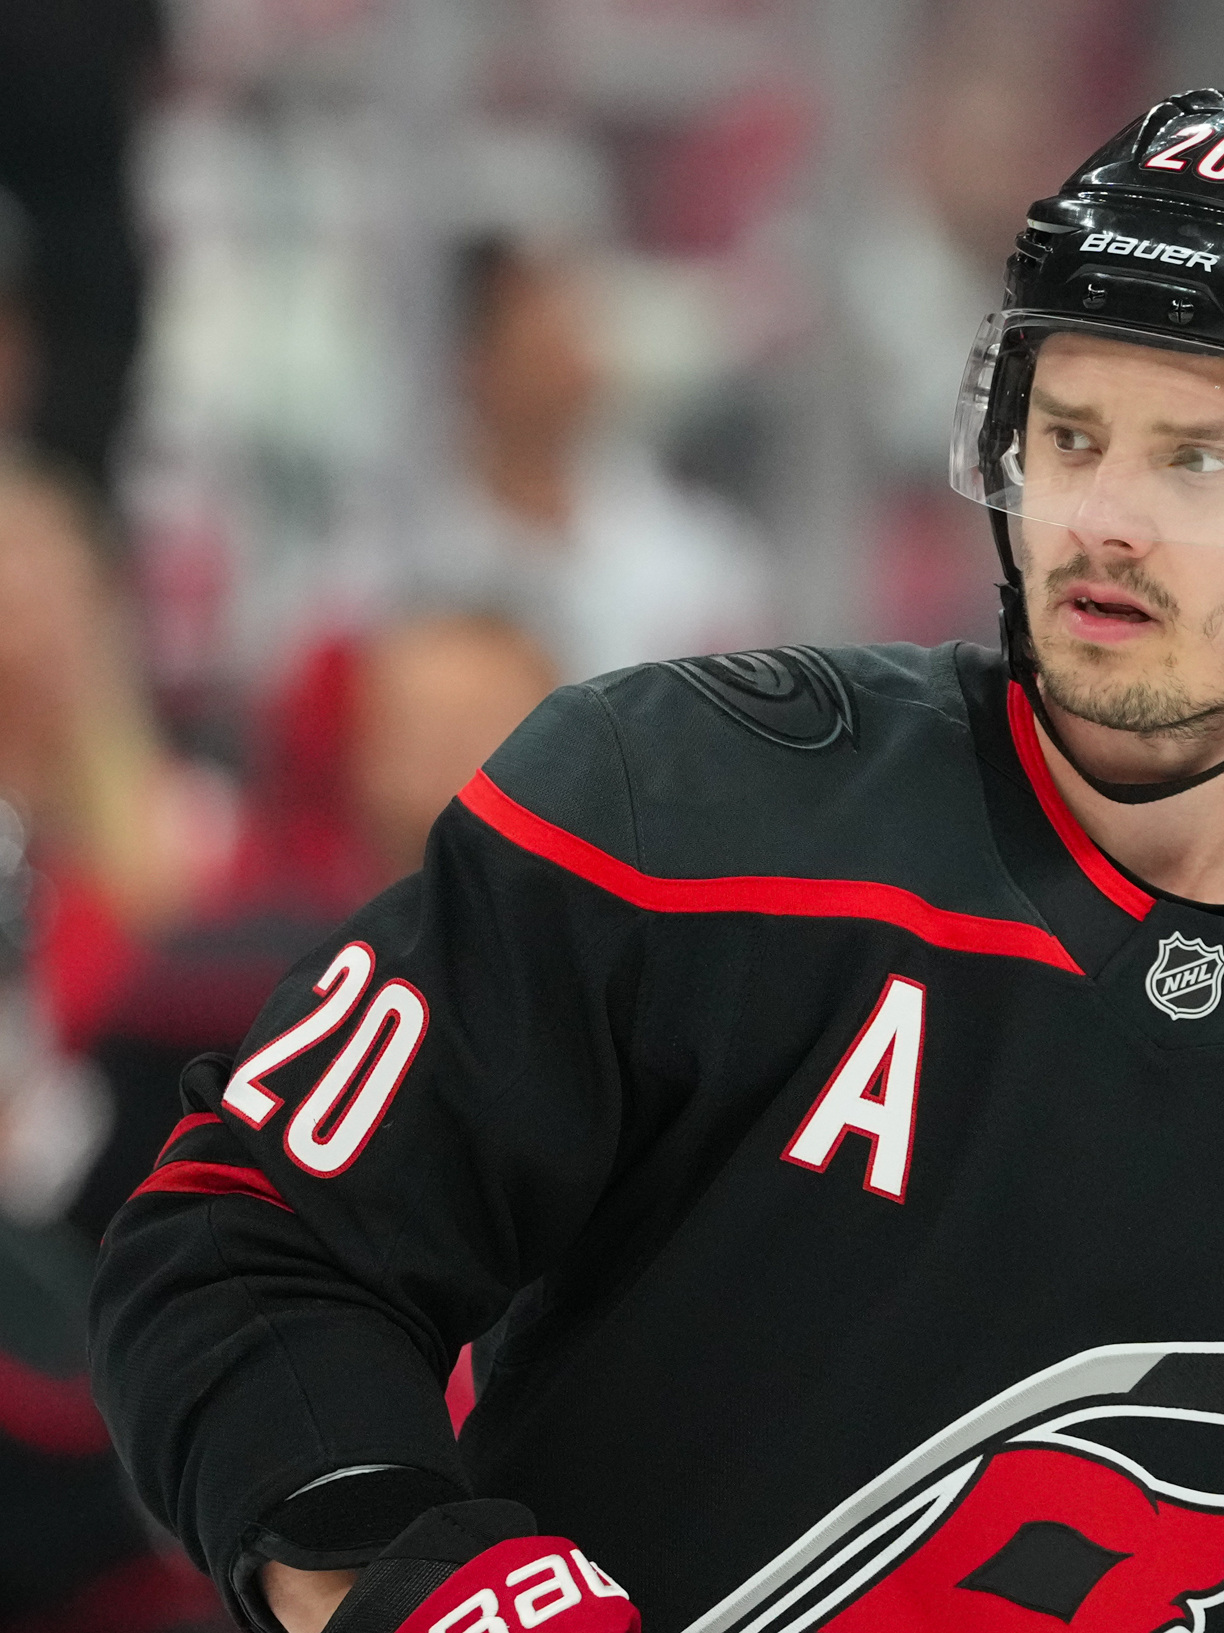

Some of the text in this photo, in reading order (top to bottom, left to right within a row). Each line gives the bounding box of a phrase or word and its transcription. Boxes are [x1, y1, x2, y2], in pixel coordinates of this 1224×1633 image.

[221, 940, 430, 1179] 20
[779, 972, 927, 1205] A
[1161, 963, 1213, 996] NHL
